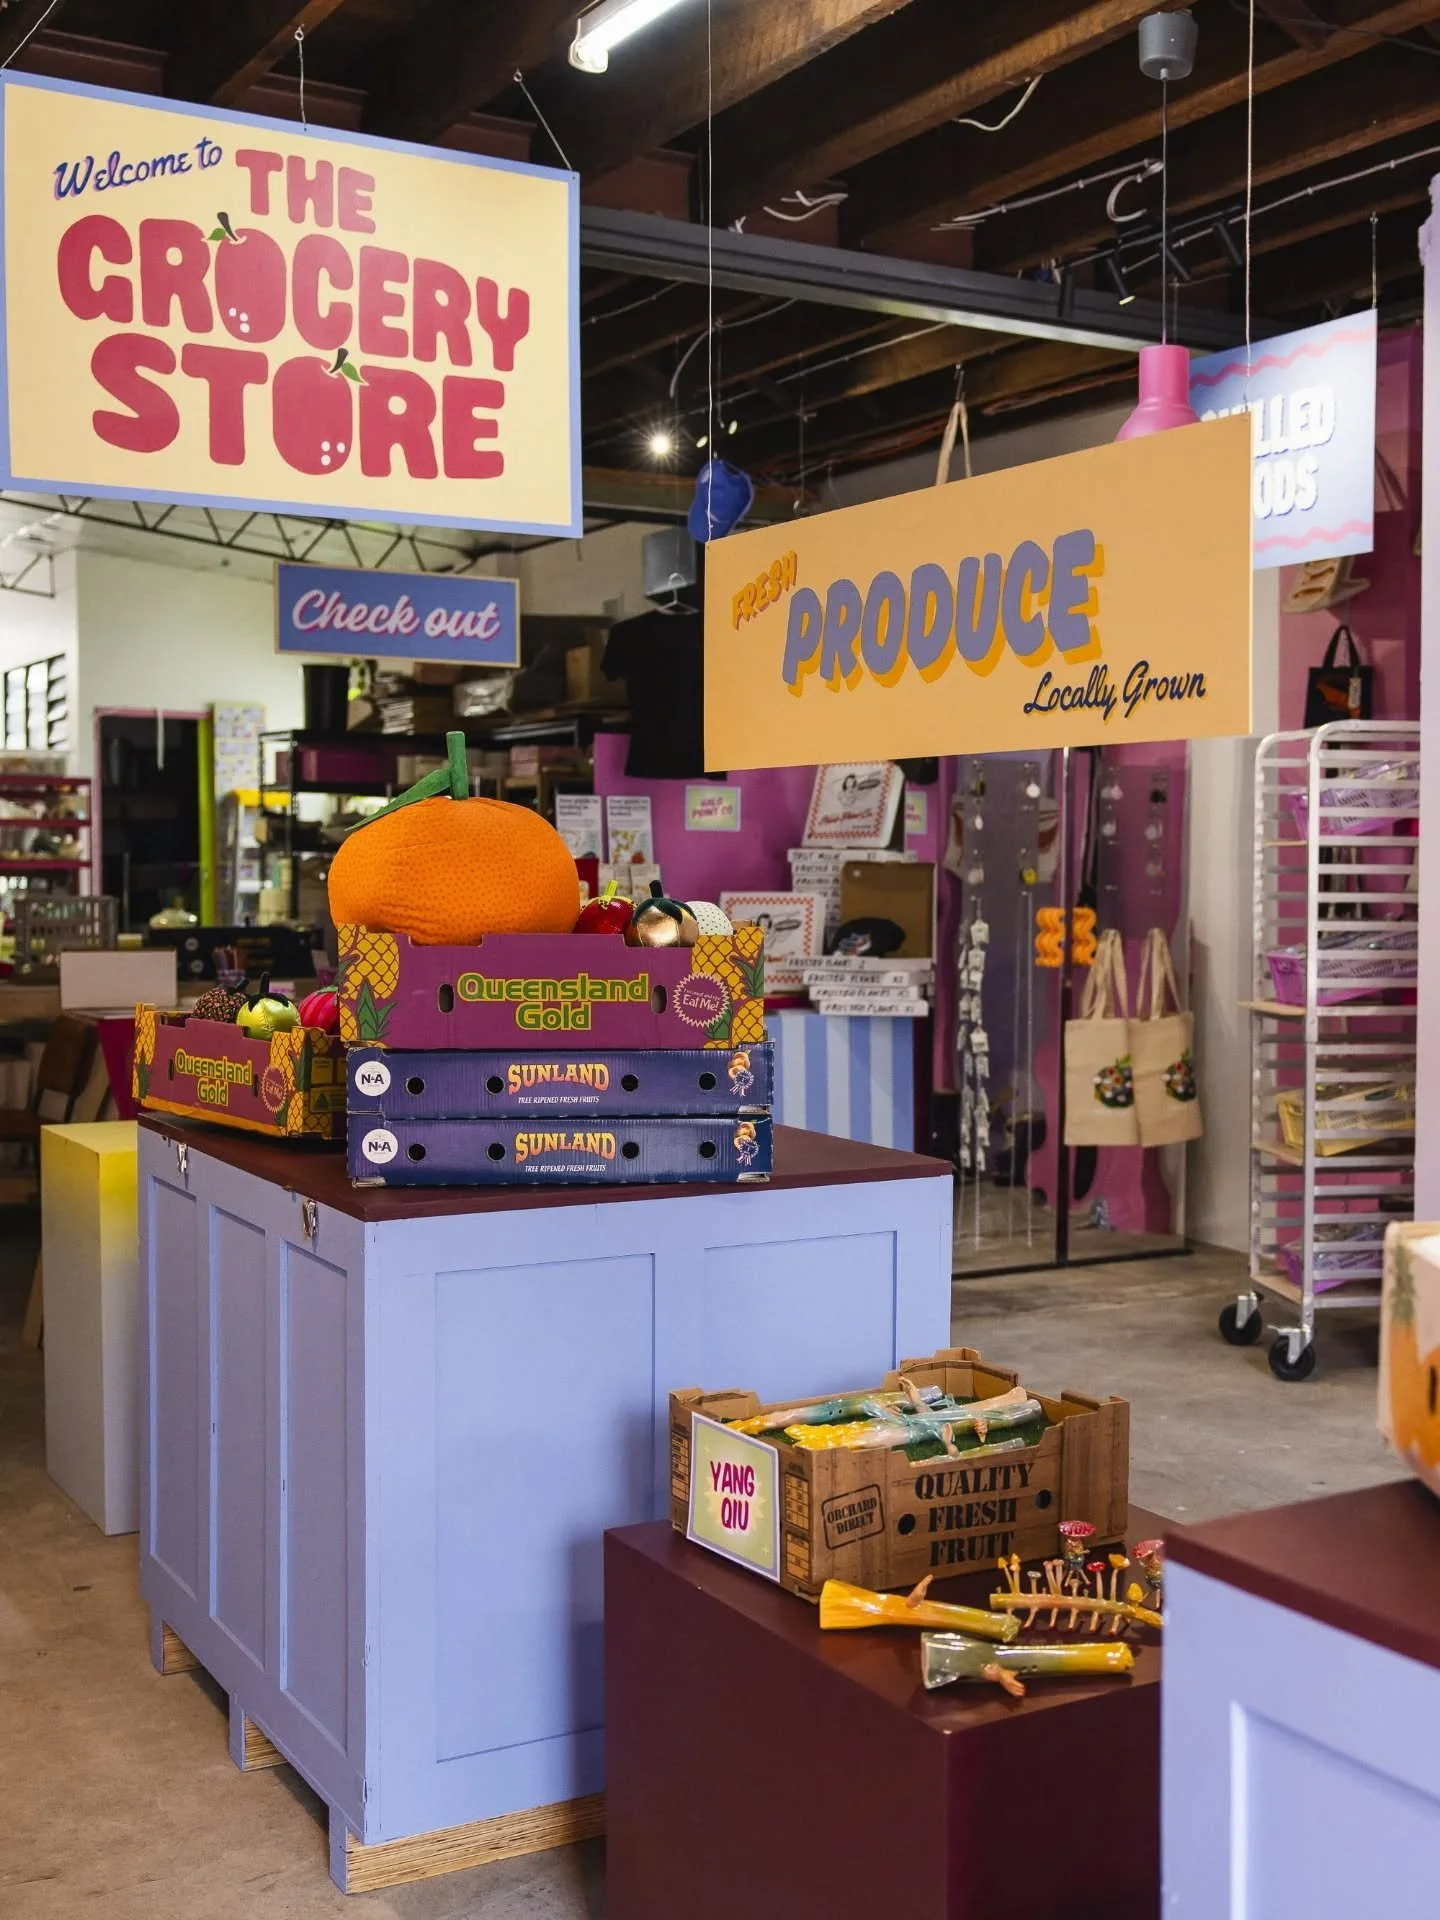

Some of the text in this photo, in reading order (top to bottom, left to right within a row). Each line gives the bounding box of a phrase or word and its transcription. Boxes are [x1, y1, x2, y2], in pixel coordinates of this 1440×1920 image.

[53, 136, 222, 200] Welcome to
[235, 149, 376, 233] THE
[57, 212, 530, 372] GROCERY
[91, 333, 505, 479] STORE
[732, 550, 798, 631] FRESH
[291, 588, 501, 642] Check out
[782, 529, 1105, 698] PRODUCE
[1023, 660, 1207, 723] Locally Grown
[457, 973, 649, 1002] Queensland
[683, 994, 719, 1011] Eat Me!
[515, 1001, 592, 1030] Gold
[174, 1048, 253, 1086] Queensland
[361, 1074, 385, 1085] N&A
[507, 1063, 609, 1096] SUNLAND
[198, 1080, 229, 1107] Gold
[533, 1096, 559, 1104] RIPENED
[559, 1096, 579, 1104] FRESH
[579, 1095, 600, 1103] FRUITS
[368, 1141, 392, 1153] N&A
[515, 1132, 616, 1164] SUNLAND
[525, 1165, 539, 1173] TREE
[585, 1164, 607, 1172] FRUITS
[709, 1460, 755, 1497] YANG
[915, 1462, 1035, 1501] QUALITY
[720, 1499, 750, 1533] QIU
[826, 1496, 878, 1525] ORCHARD
[836, 1513, 875, 1535] DIRECT
[928, 1498, 1017, 1533] FRESH
[929, 1530, 1015, 1568] FRUIT
